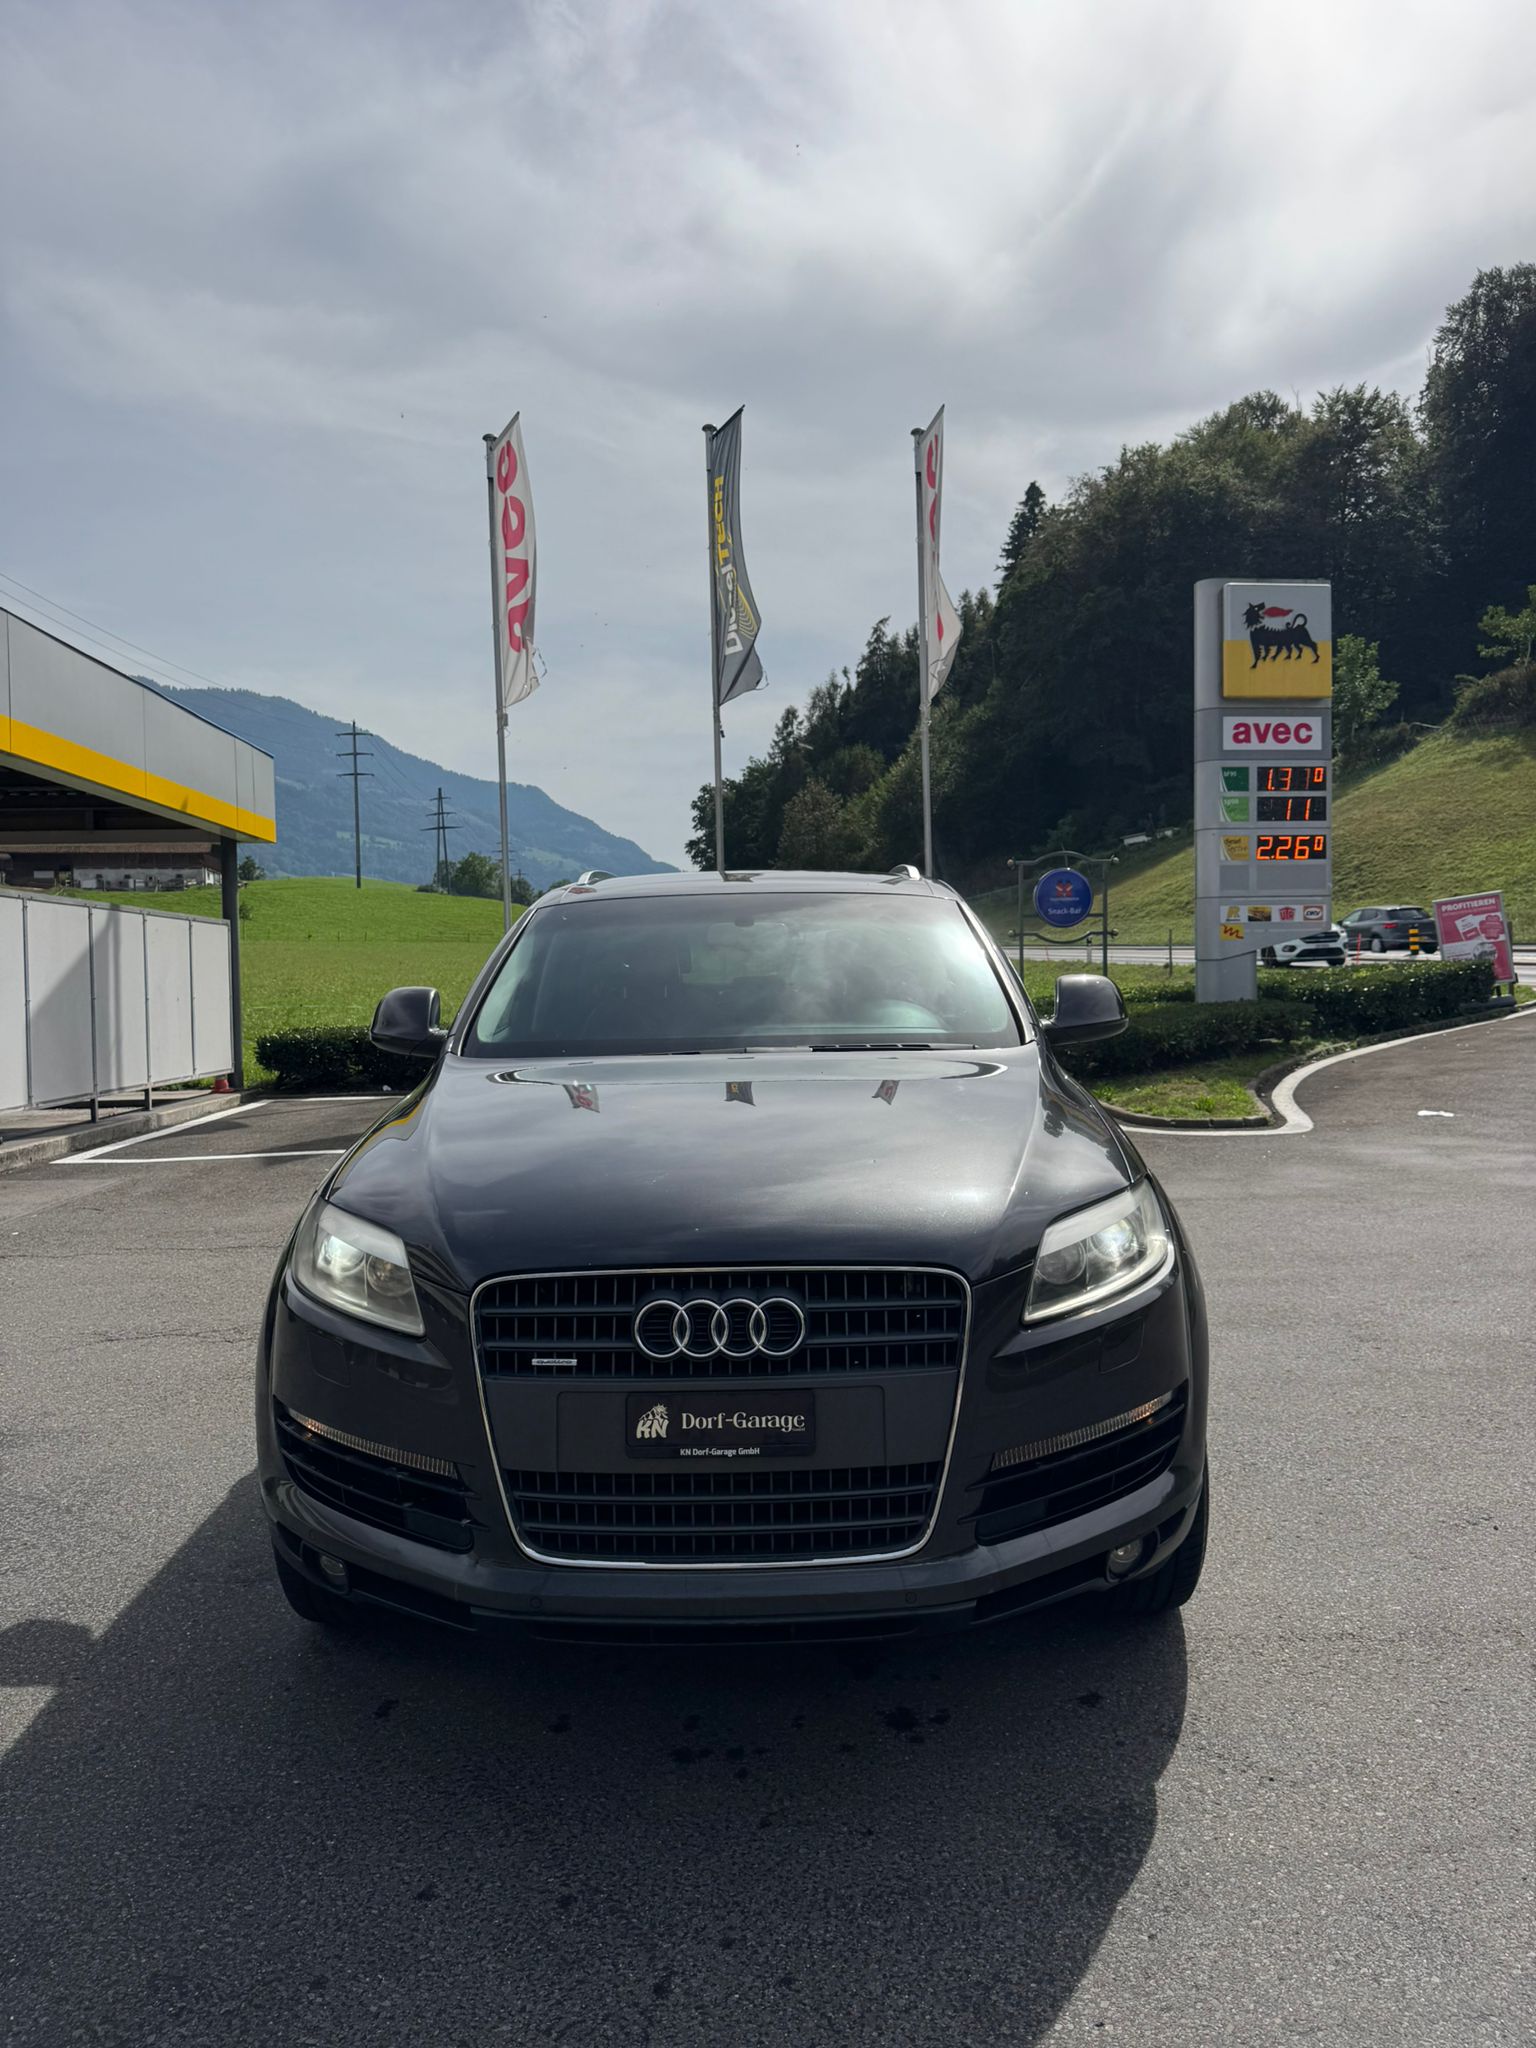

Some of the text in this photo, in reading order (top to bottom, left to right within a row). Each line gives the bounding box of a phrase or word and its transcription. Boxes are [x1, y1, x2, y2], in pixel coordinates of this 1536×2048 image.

[496, 440, 530, 653] avec
[1232, 721, 1313, 745] avec
[1441, 898, 1496, 912] PROFITIEREN
[681, 1411, 805, 1432] Dorf-Garage
[680, 1447, 760, 1458] KN Dorf-Garage GmbH
